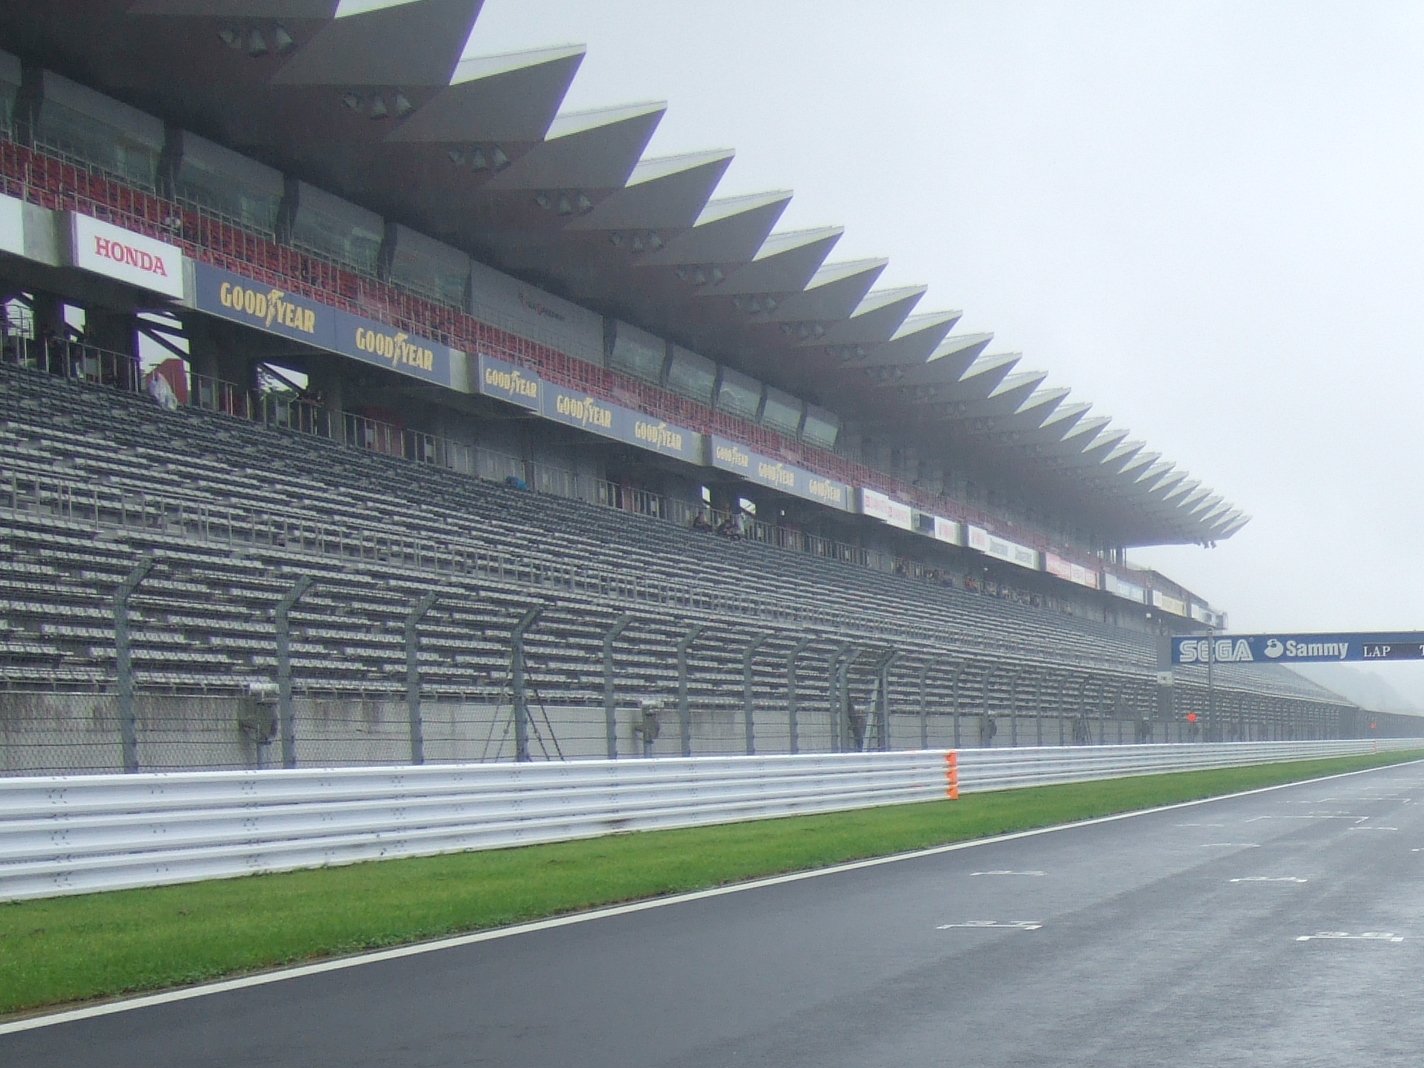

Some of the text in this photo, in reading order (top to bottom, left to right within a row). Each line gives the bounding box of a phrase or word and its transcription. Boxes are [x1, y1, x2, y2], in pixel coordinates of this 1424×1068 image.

[94, 235, 168, 278] HONDA
[1179, 639, 1254, 663] SEGA
[1286, 640, 1349, 660] Sammy
[1363, 646, 1391, 657] LAP
